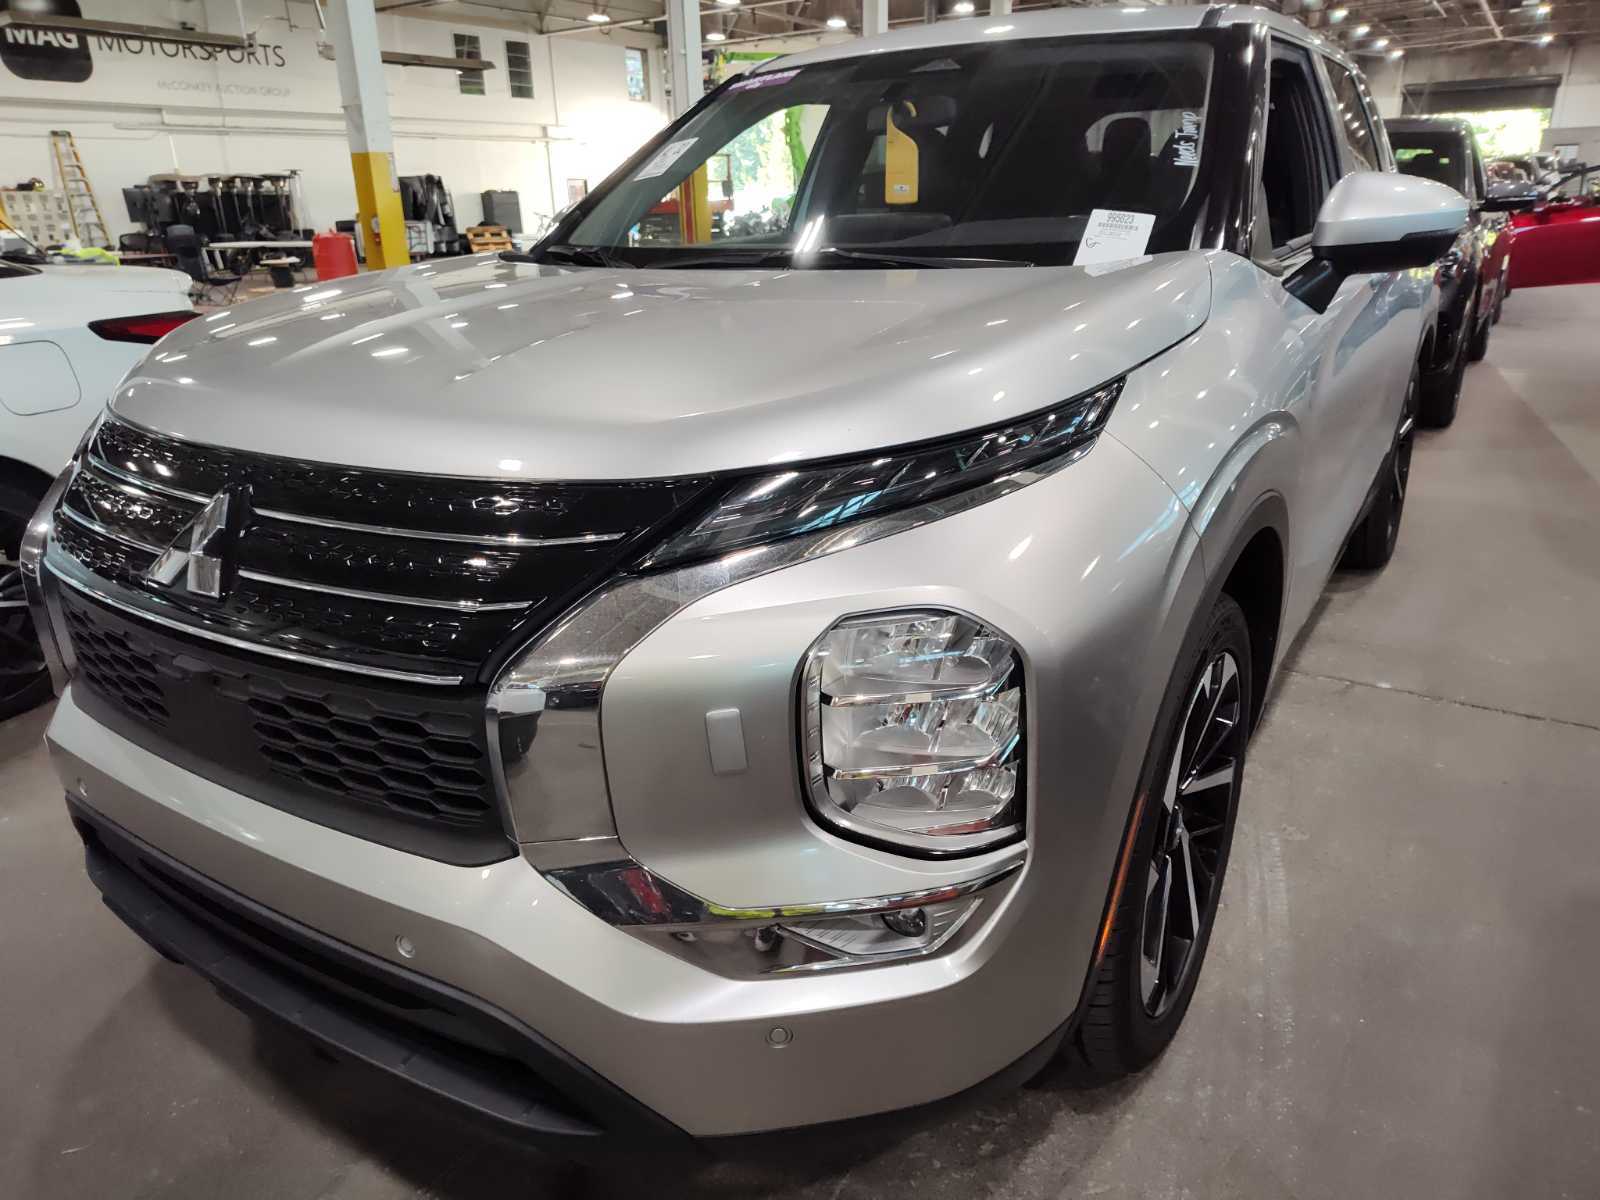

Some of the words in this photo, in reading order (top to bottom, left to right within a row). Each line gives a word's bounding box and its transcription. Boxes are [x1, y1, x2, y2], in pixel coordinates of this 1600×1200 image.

[5, 28, 79, 49] MAG
[98, 35, 286, 68] MOTORSPORTS
[1173, 141, 1199, 166] Needs
